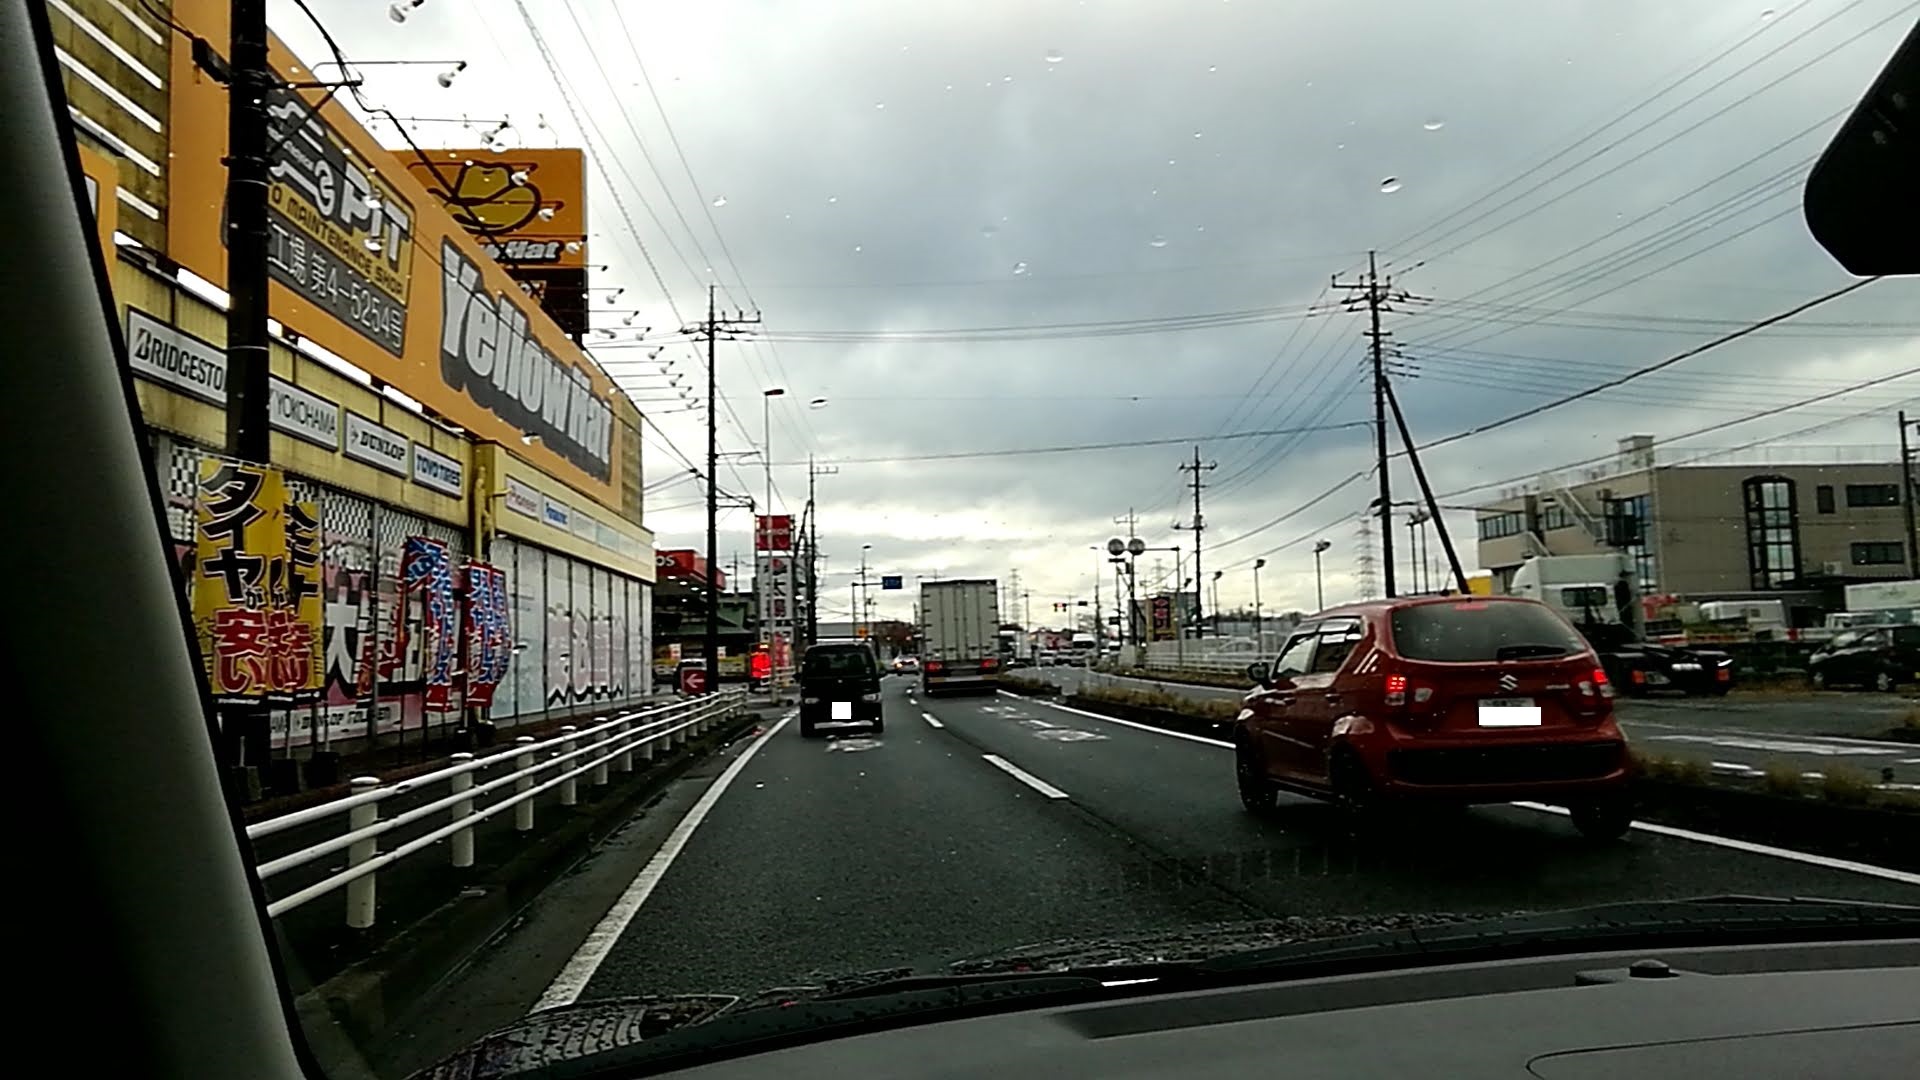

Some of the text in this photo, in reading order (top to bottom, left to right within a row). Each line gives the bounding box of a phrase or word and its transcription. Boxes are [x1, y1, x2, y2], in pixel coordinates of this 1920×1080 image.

[339, 162, 409, 262] PIT
[287, 200, 403, 295] MAINTENANCE SHOP
[133, 327, 227, 391] BRIDGESTO
[275, 391, 338, 437] YOKOHAMA
[359, 429, 407, 462] DUNLOP
[655, 554, 676, 567] OS
